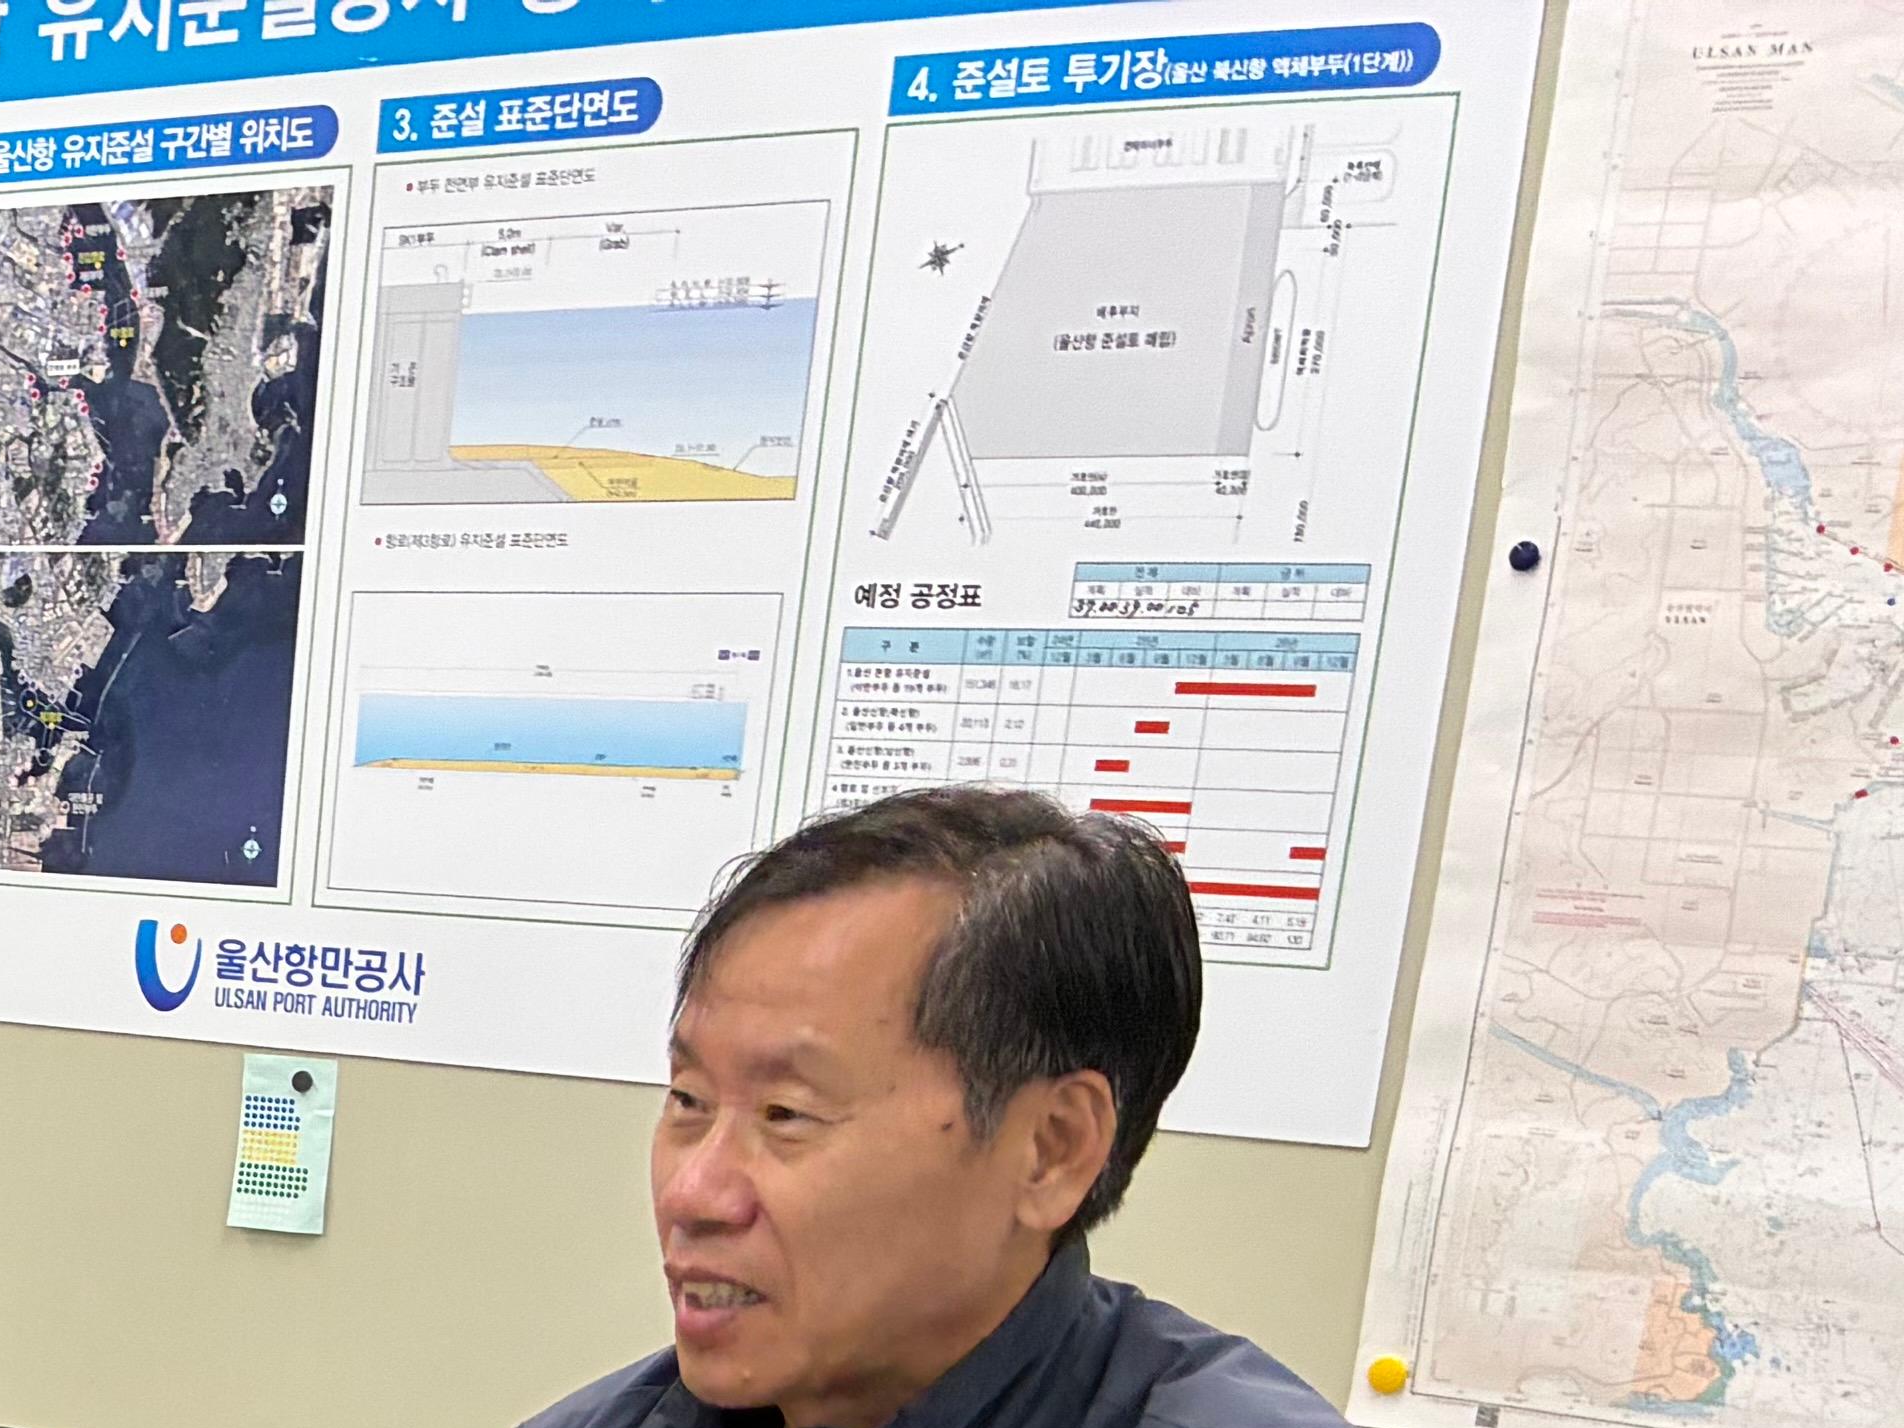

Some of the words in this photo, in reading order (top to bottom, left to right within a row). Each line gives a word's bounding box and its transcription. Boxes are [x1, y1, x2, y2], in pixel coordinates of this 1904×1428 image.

[908, 70, 937, 102] 4.
[953, 57, 1049, 101] 준설토
[393, 108, 418, 141] 3.
[430, 99, 487, 139] 준설
[494, 89, 639, 132] 표준단면도
[61, 128, 154, 168] 유지준설
[160, 121, 233, 161] 구간별
[240, 116, 314, 155] 위치도
[855, 583, 901, 609] 예정
[910, 583, 982, 609] 공정표
[216, 938, 426, 996] 울산항만공사
[214, 986, 268, 1012] ULSAN
[273, 991, 317, 1016] PORT
[321, 995, 418, 1024] AUTHORITY
